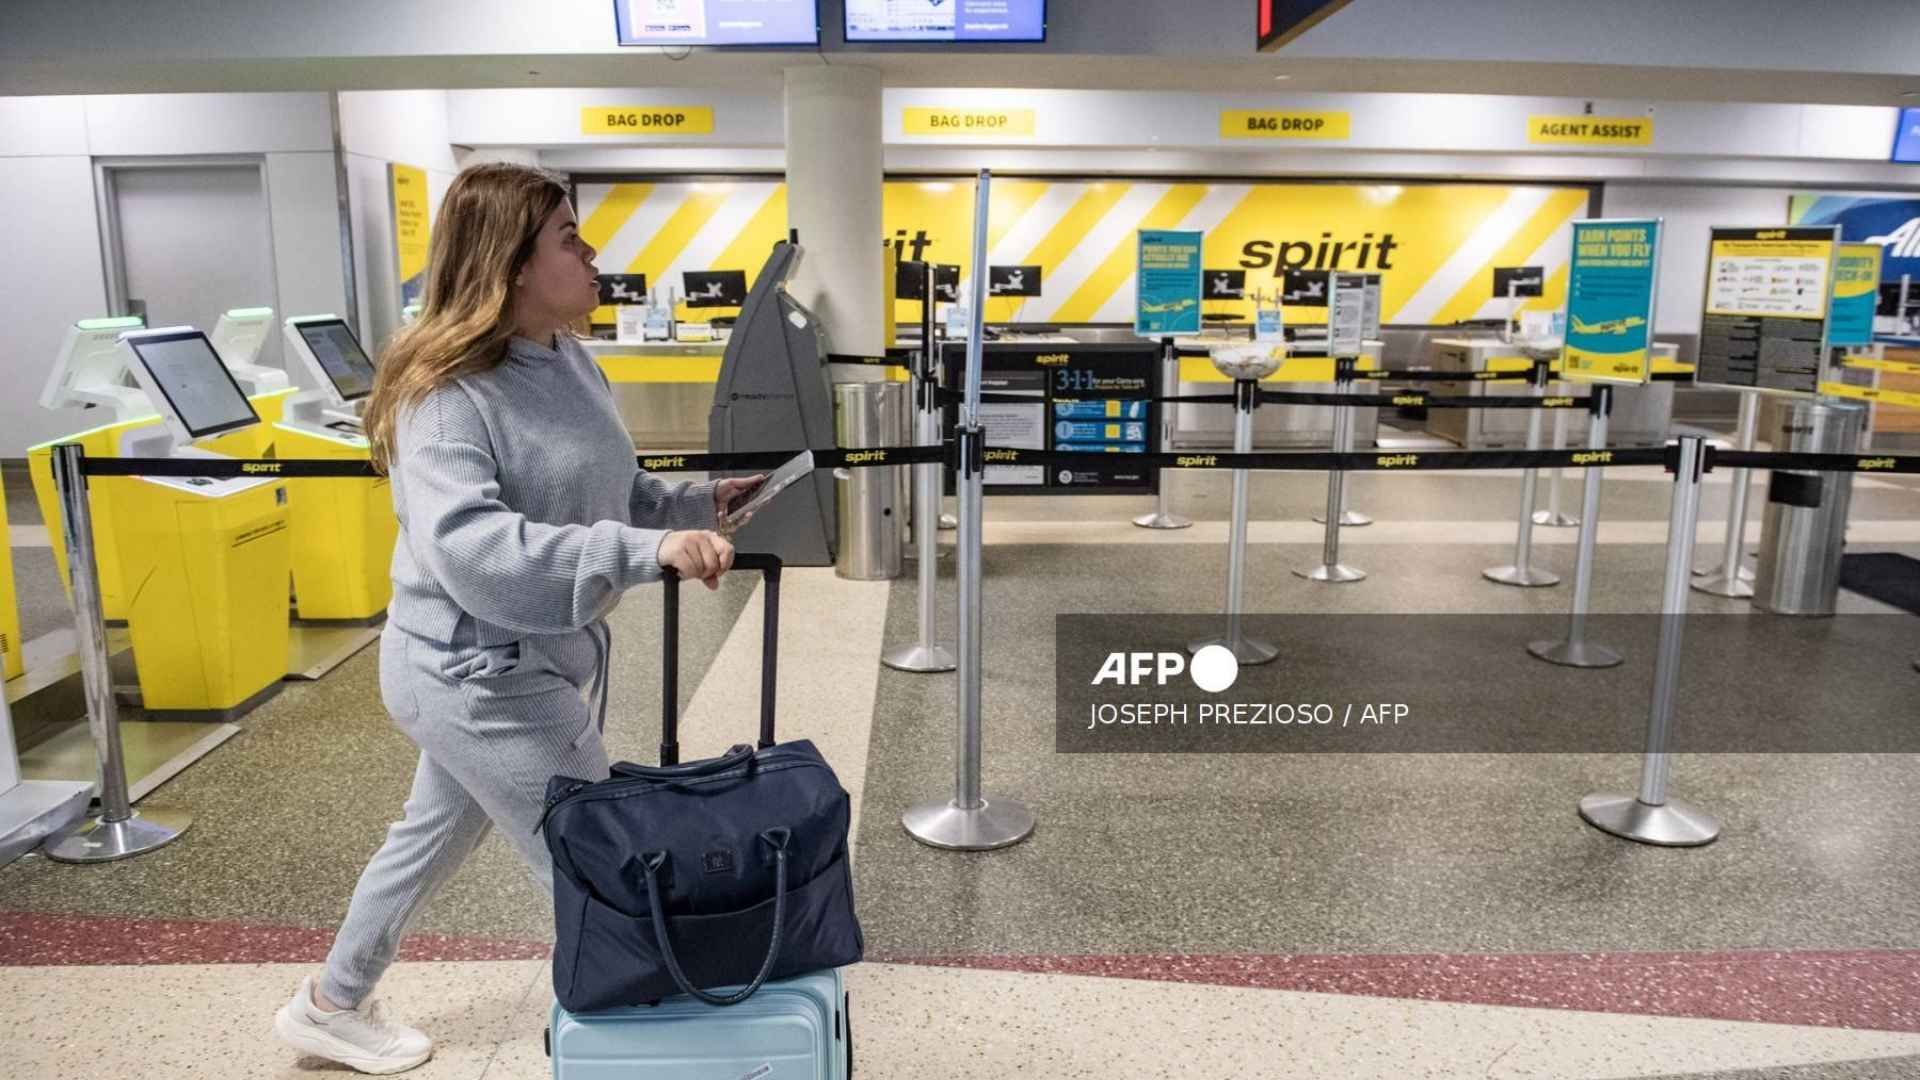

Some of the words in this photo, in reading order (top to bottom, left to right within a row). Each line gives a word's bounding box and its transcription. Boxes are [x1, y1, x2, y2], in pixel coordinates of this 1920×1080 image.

[607, 114, 637, 127] BAG
[641, 114, 685, 127] DROP
[929, 115, 960, 128] BAG
[965, 115, 1008, 128] DROP
[1247, 117, 1278, 131] BAG
[1282, 118, 1324, 131] DROP
[1539, 123, 1588, 138] AGENT
[1591, 124, 1641, 138] ASSIST
[1608, 228, 1647, 242] POINTS
[1239, 232, 1398, 277] spirit
[1036, 354, 1070, 365] spirit
[1391, 395, 1424, 406] spirit
[643, 455, 685, 469] spirit
[845, 450, 887, 464] spirit
[1176, 453, 1218, 467] spirit
[1377, 453, 1419, 467] spirit
[1572, 450, 1614, 464] spirit
[1858, 458, 1896, 470] spirit
[242, 462, 282, 474] spirit
